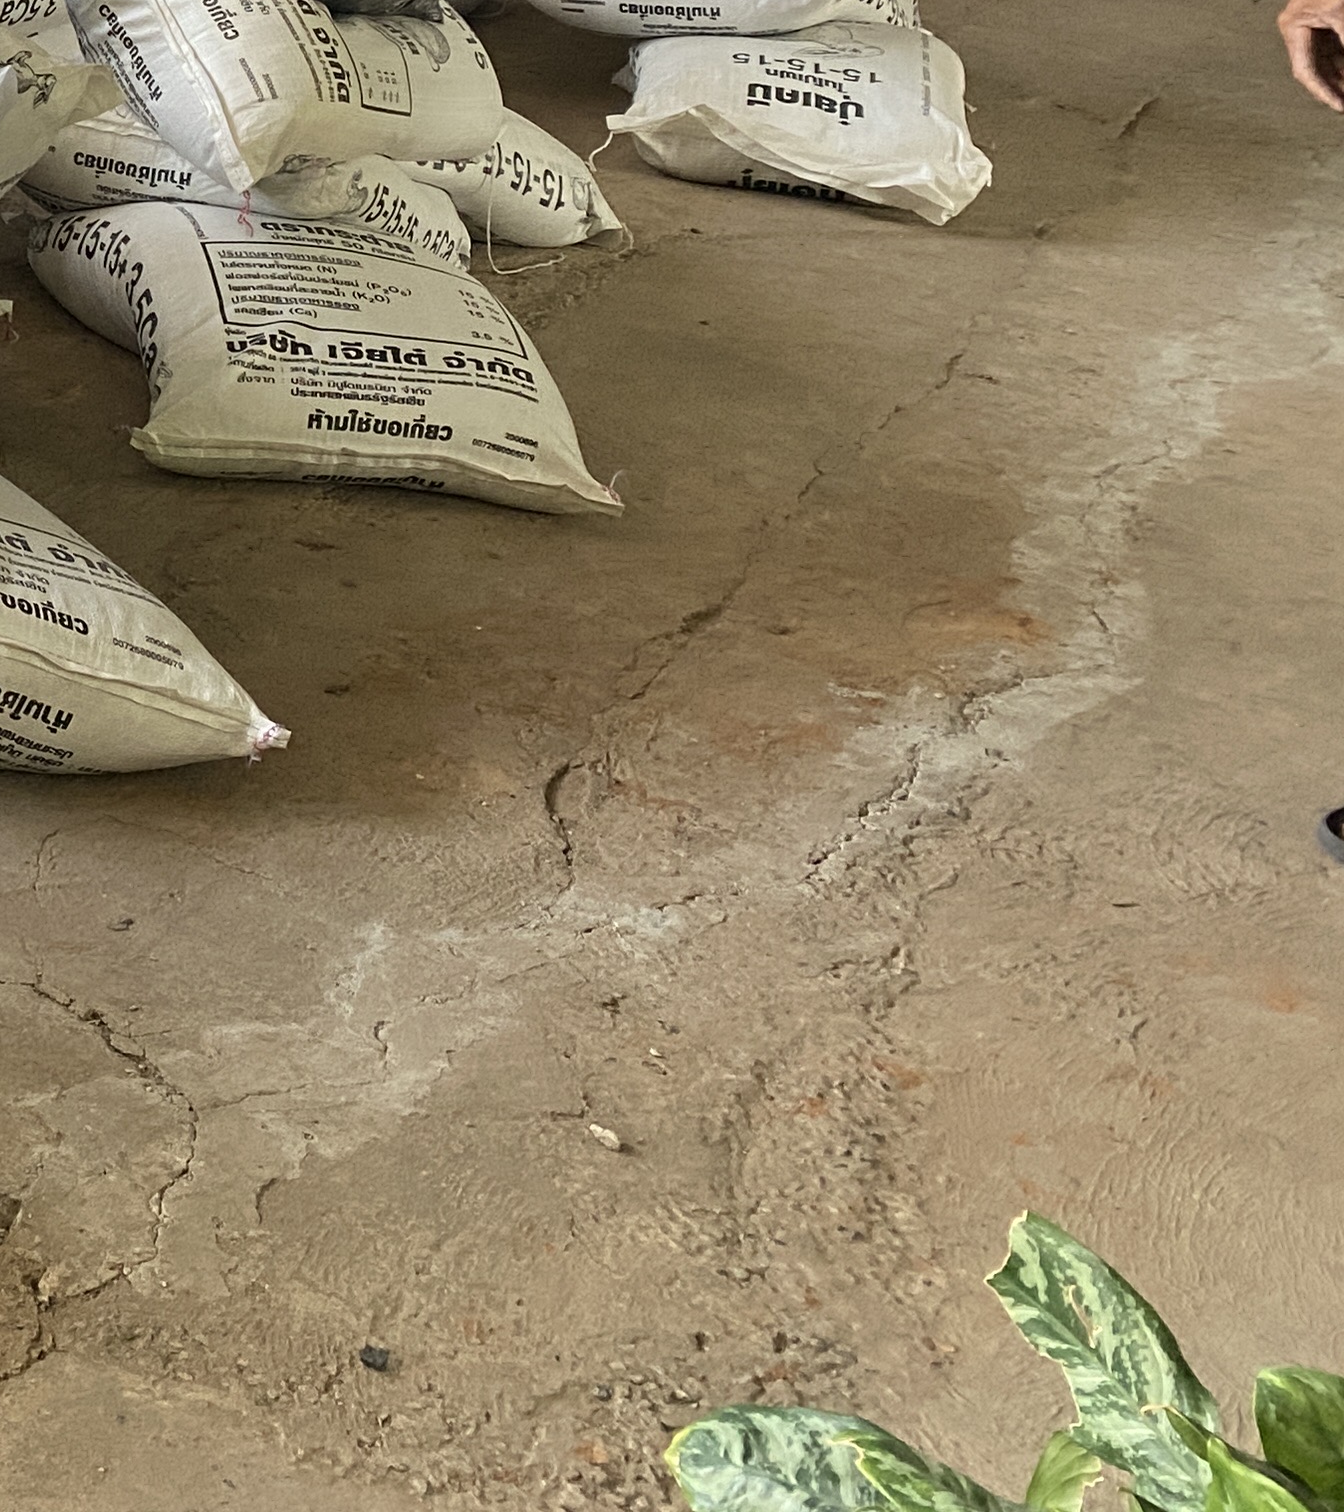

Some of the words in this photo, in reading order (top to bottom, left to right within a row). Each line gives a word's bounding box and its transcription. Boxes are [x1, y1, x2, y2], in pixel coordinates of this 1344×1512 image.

[746, 82, 865, 126] ปุ๋ยเคมี
[442, 349, 535, 386] จำกัด
[306, 408, 453, 443] ห้ามใช้ขอเกี่ยว
